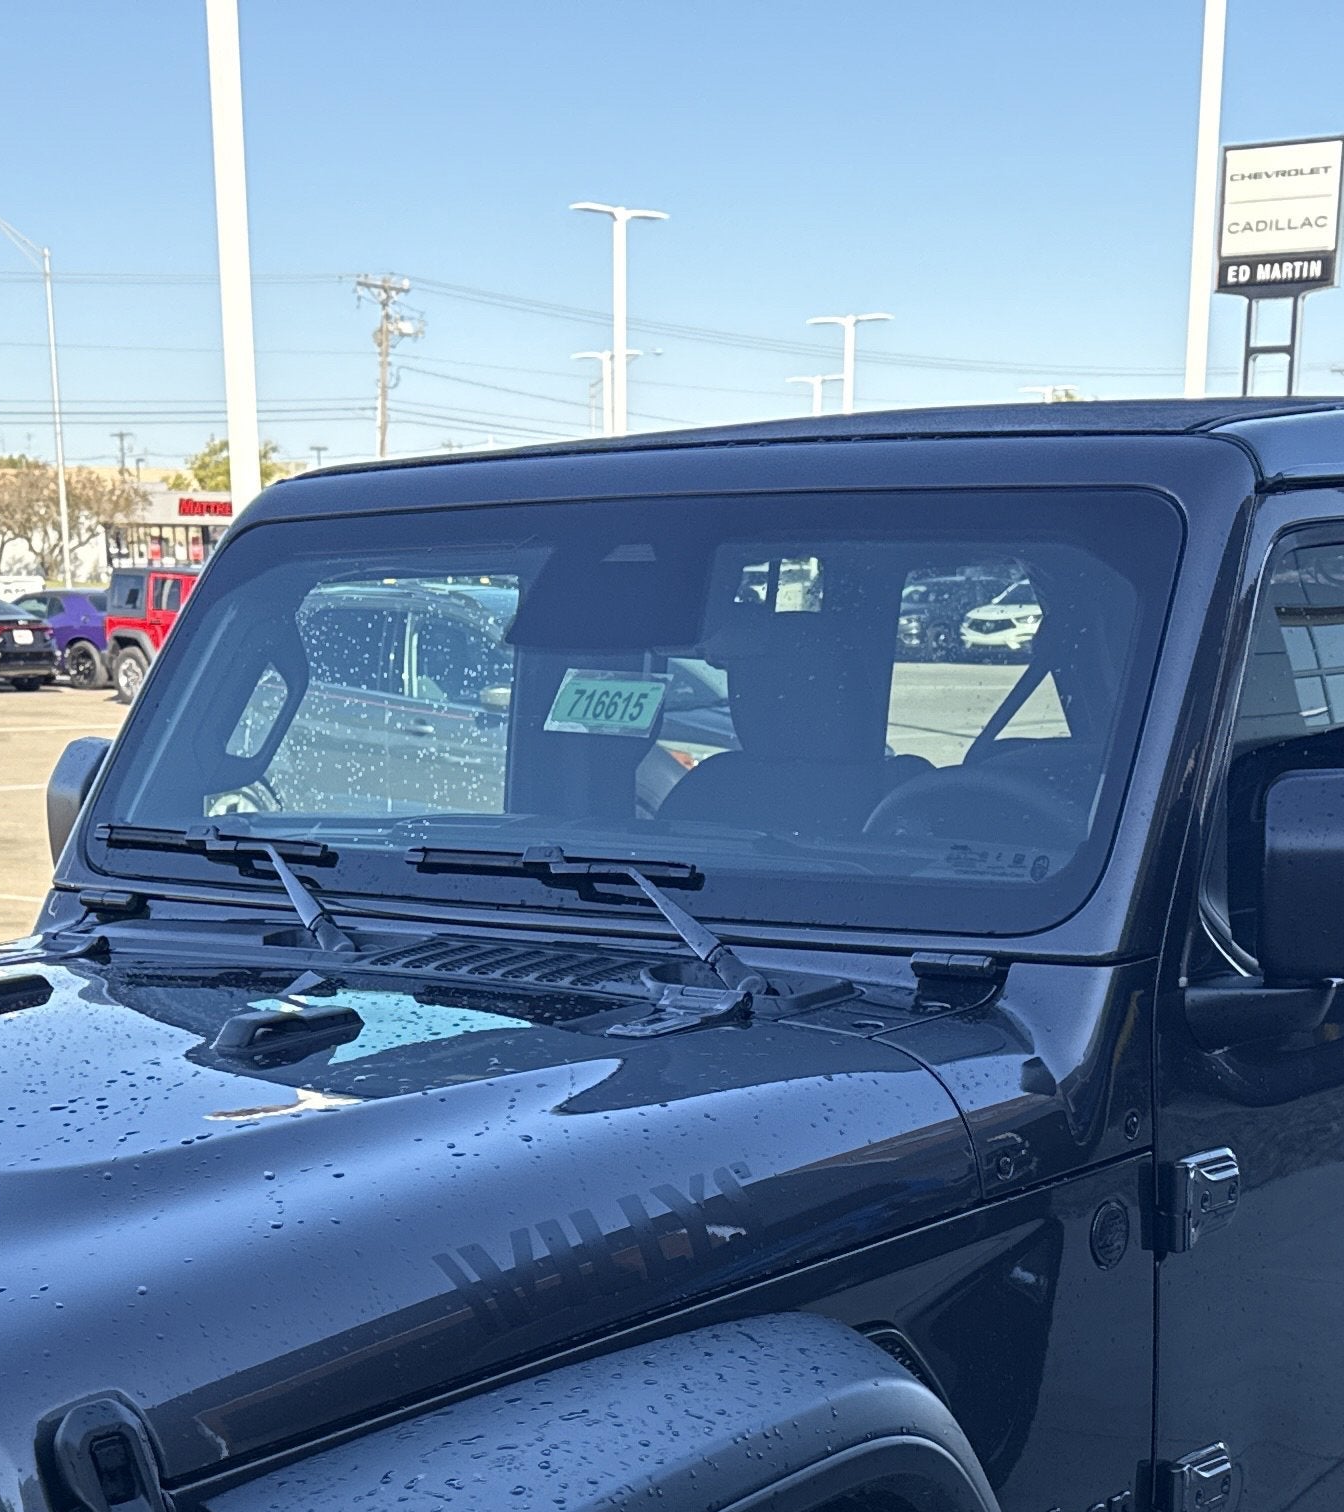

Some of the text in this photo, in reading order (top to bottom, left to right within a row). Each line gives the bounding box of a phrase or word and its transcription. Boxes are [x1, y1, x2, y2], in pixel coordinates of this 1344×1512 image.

[1229, 165, 1333, 183] CHEVROLET
[1227, 215, 1329, 235] CADILLAC
[1227, 260, 1323, 284] ED MARTIN
[567, 689, 649, 722] 716615
